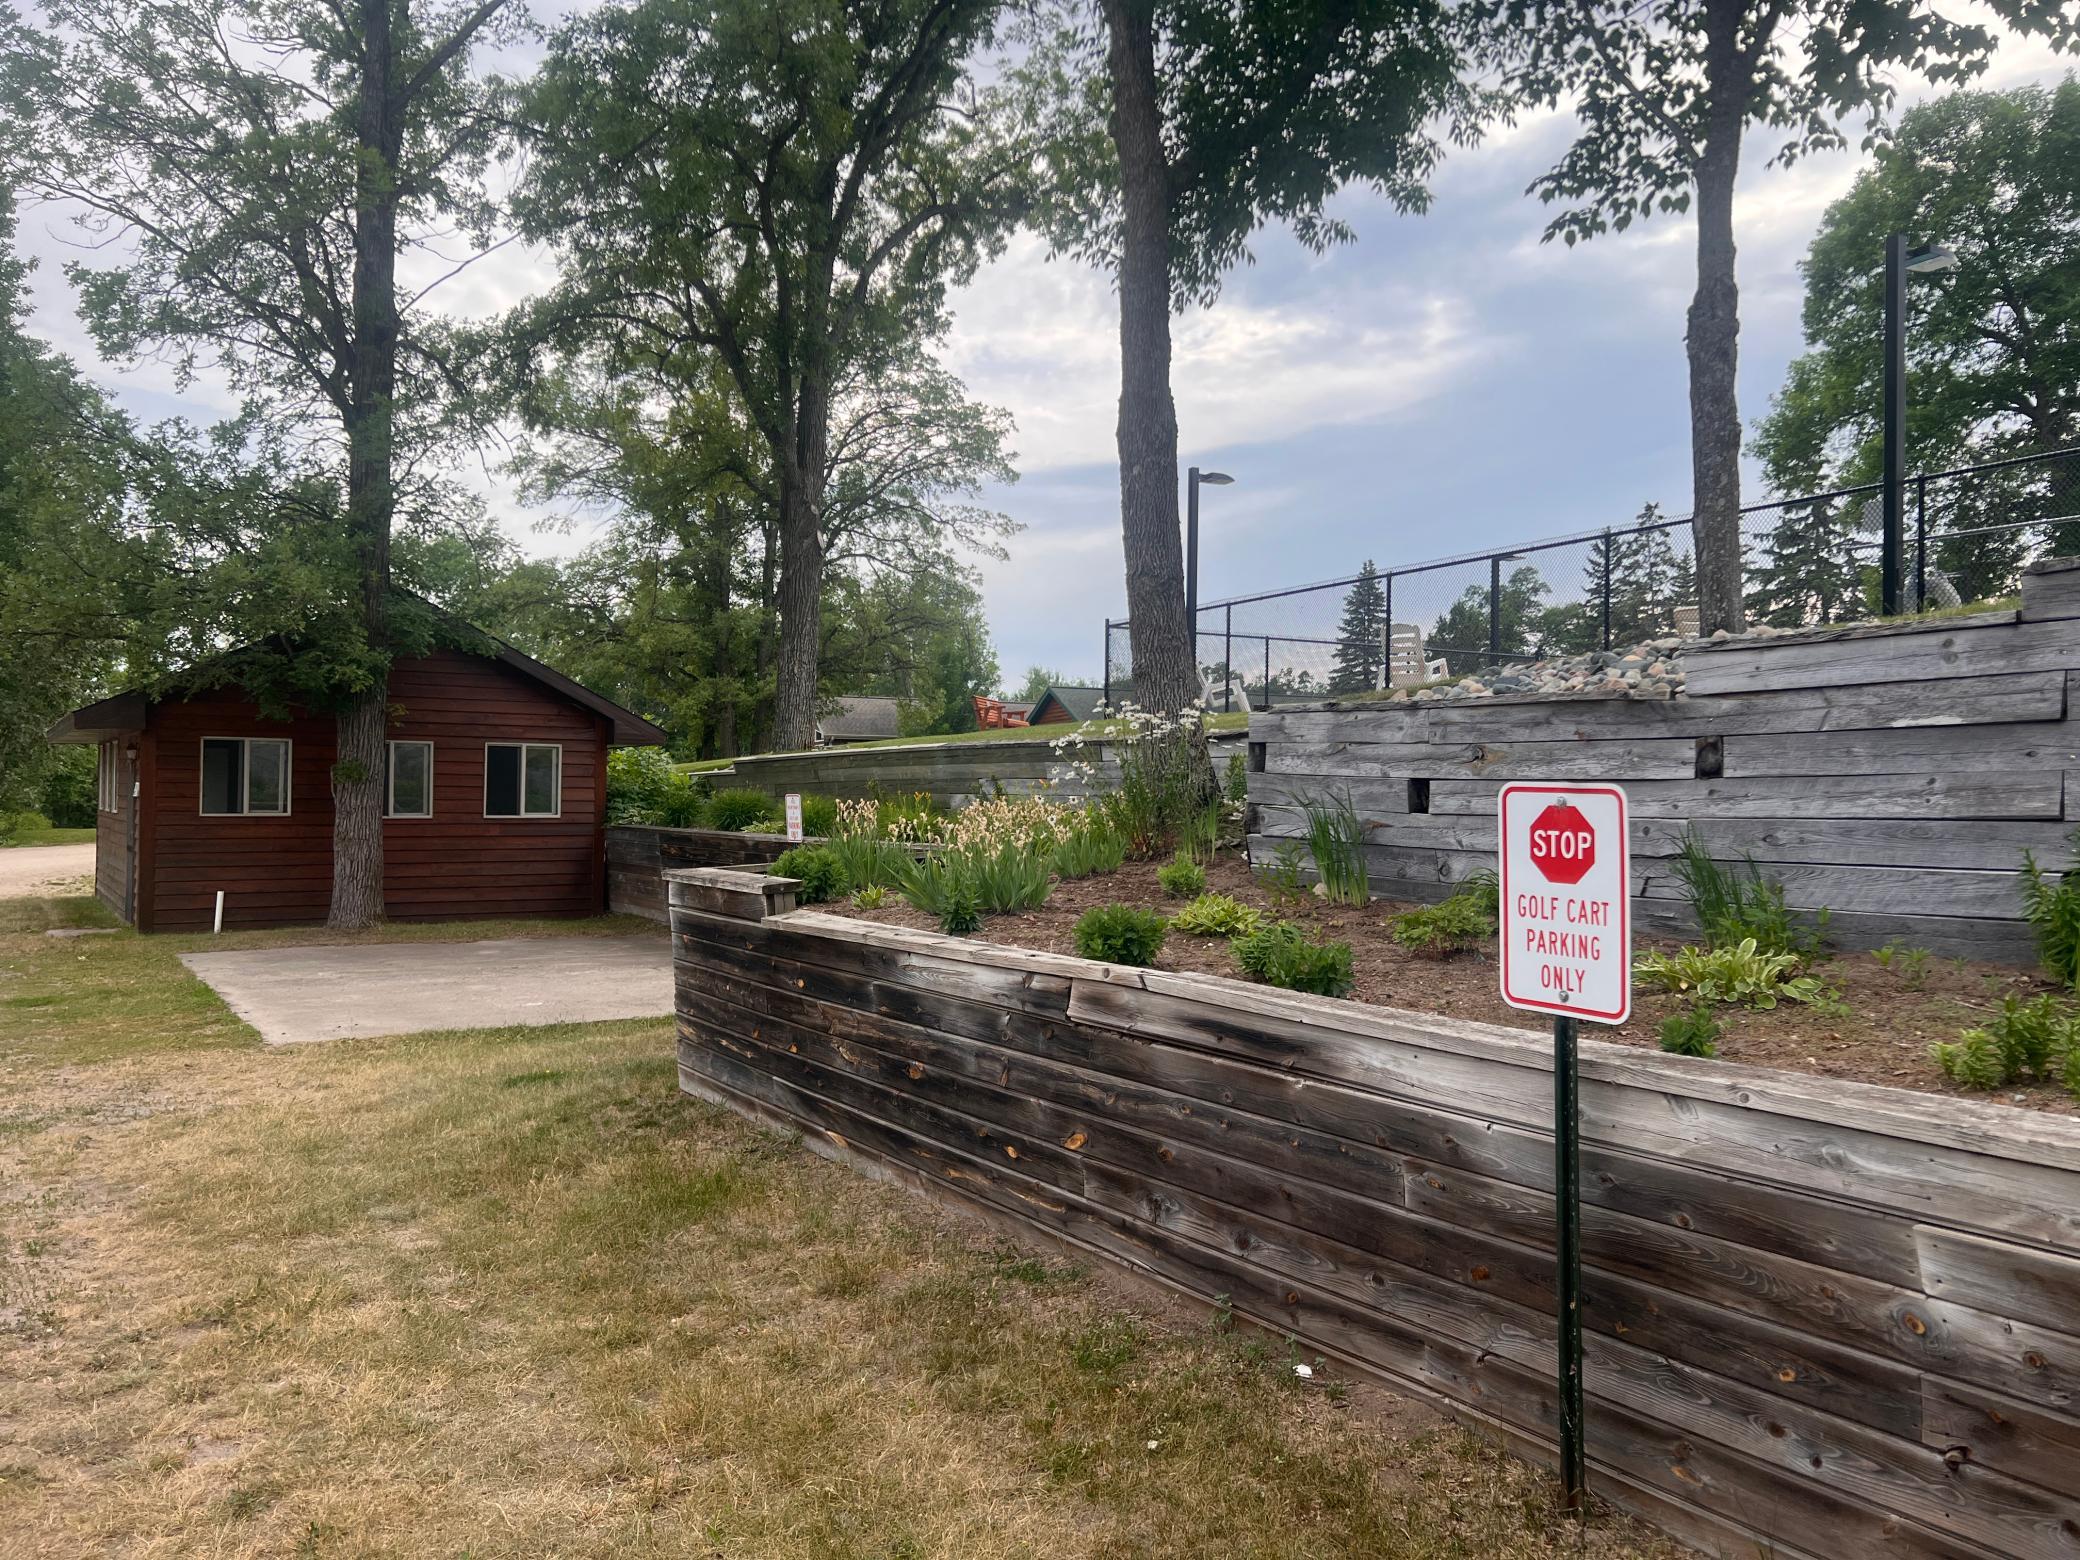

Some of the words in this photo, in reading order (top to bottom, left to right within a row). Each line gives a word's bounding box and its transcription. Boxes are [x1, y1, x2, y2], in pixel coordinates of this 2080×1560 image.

[1533, 830, 1592, 859] STOP
[1518, 894, 1558, 920] GOLF
[1567, 898, 1609, 926] CART
[1527, 929, 1600, 960] PARKING
[1541, 964, 1585, 993] ONLY
